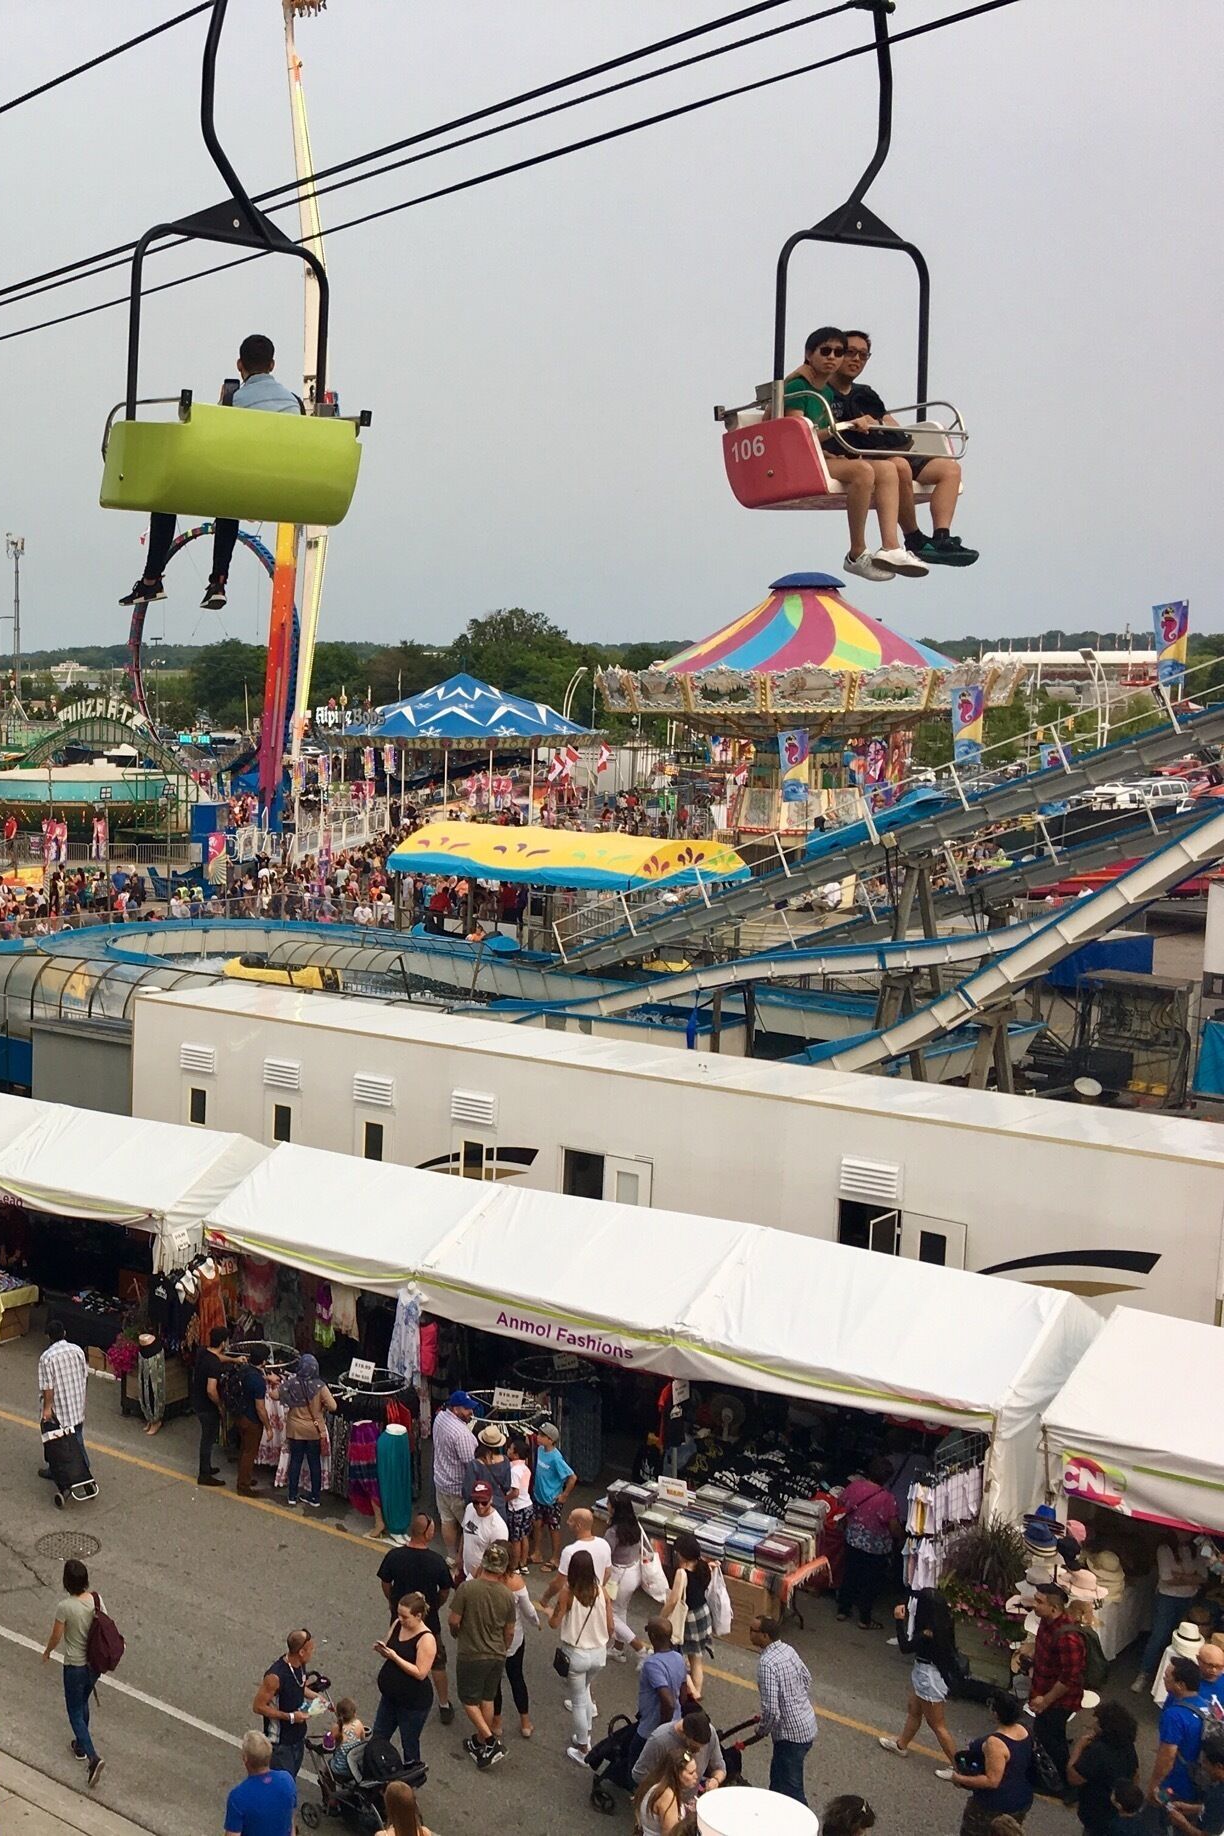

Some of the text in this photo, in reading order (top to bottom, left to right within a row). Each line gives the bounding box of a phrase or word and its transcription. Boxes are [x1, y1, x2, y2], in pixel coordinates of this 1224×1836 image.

[732, 435, 765, 462] 106
[352, 708, 386, 726] Bobs
[496, 1311, 634, 1359] Anmol Fashions
